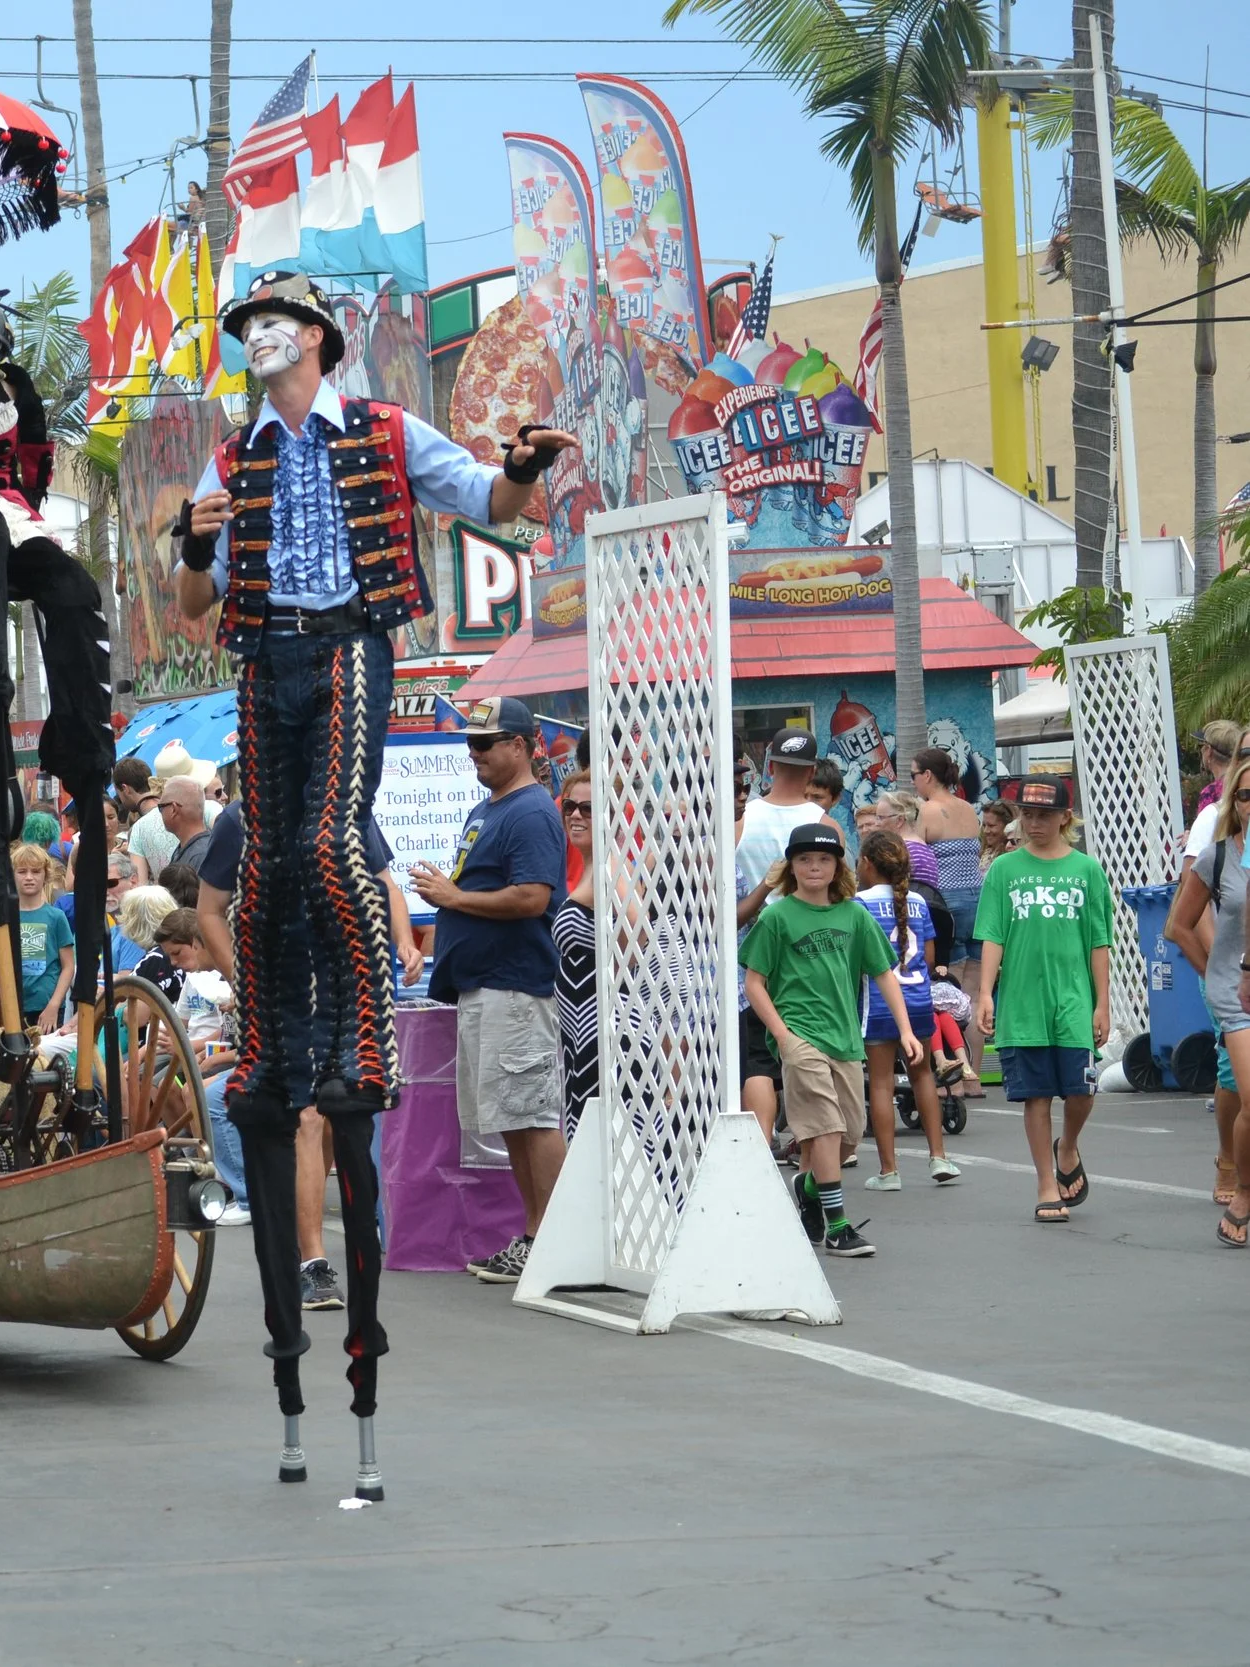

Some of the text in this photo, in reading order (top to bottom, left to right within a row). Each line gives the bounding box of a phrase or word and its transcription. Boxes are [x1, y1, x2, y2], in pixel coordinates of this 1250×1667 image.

[714, 384, 777, 429] EXPERIENCE
[744, 397, 819, 445] ICEE
[676, 432, 733, 476] ICEE
[812, 429, 866, 466] ICEE
[723, 455, 762, 480] THE
[729, 461, 823, 493] ORIGINAL!
[515, 525, 544, 540] PEP
[729, 578, 892, 603] MILE LONG HOT DOG
[840, 725, 880, 759] ICEE
[400, 754, 460, 778] SUMMER
[384, 788, 443, 807] Tonight
[447, 790, 466, 802] on
[374, 807, 463, 827] Grandstand
[395, 833, 449, 851] Charlie
[1008, 875, 1088, 889] JAKES CAKES
[878, 901, 923, 919] LEUX
[798, 942, 815, 953] OFF
[814, 938, 832, 952] THE
[809, 929, 833, 942] VANS
